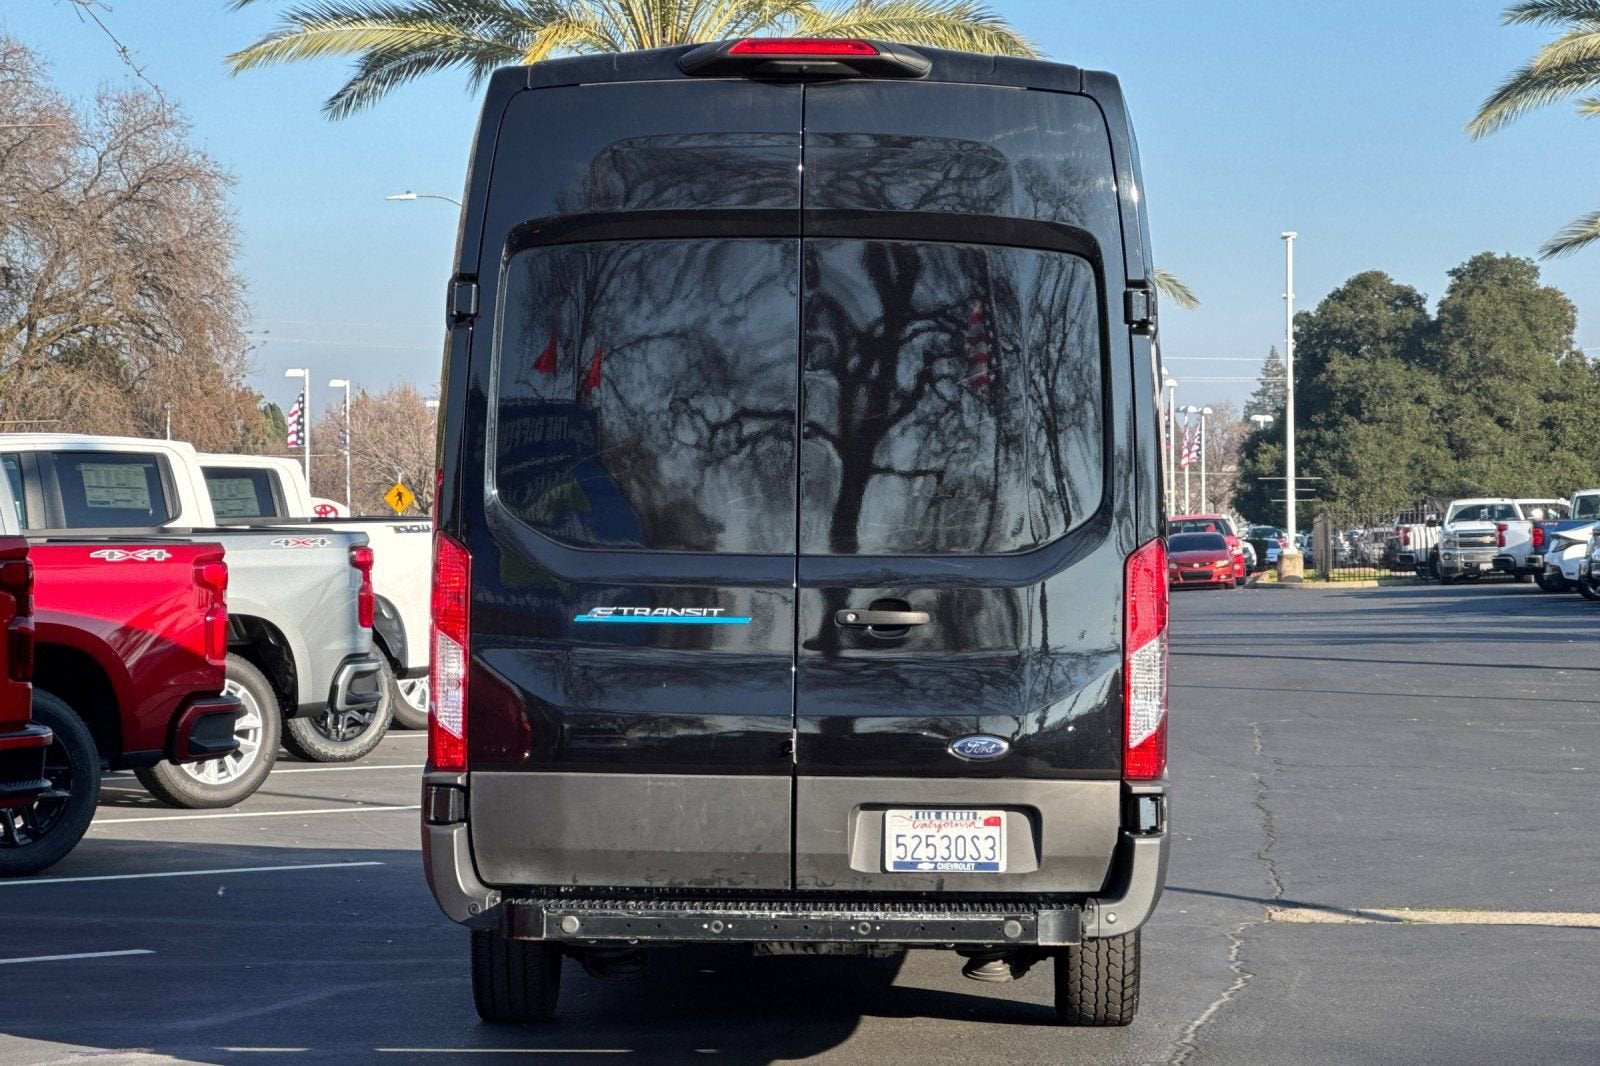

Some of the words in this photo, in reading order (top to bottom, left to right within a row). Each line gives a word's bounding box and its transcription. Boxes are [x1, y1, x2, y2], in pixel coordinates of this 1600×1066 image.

[964, 740, 996, 754] Ford
[918, 811, 936, 820] ELK
[941, 811, 974, 821] GROVE
[912, 820, 983, 833] California
[896, 834, 996, 861] 52530S3
[937, 862, 976, 871] CHEVROLET
